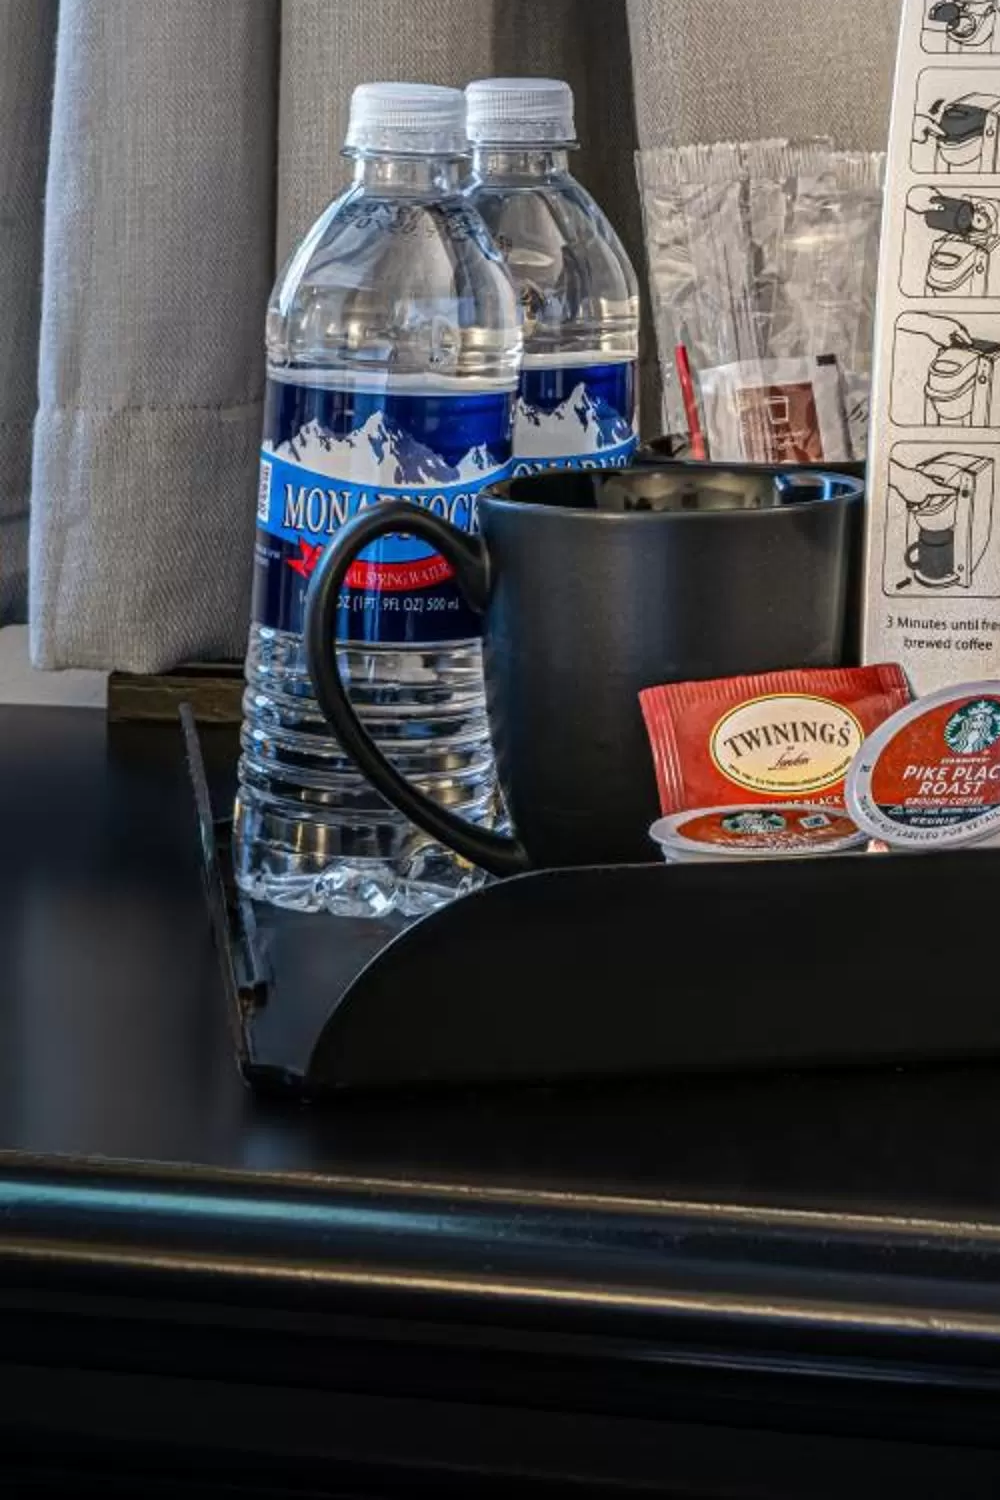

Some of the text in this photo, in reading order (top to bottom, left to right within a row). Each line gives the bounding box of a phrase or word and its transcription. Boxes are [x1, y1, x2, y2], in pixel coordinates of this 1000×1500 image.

[366, 570, 408, 587] SPRING
[409, 563, 450, 584] WATER
[886, 616, 893, 629] 3
[897, 615, 947, 630] Minutes
[950, 617, 979, 630] until
[903, 637, 993, 650] brewed coffee
[902, 764, 950, 781] PIKE
[918, 781, 985, 795] ROAST
